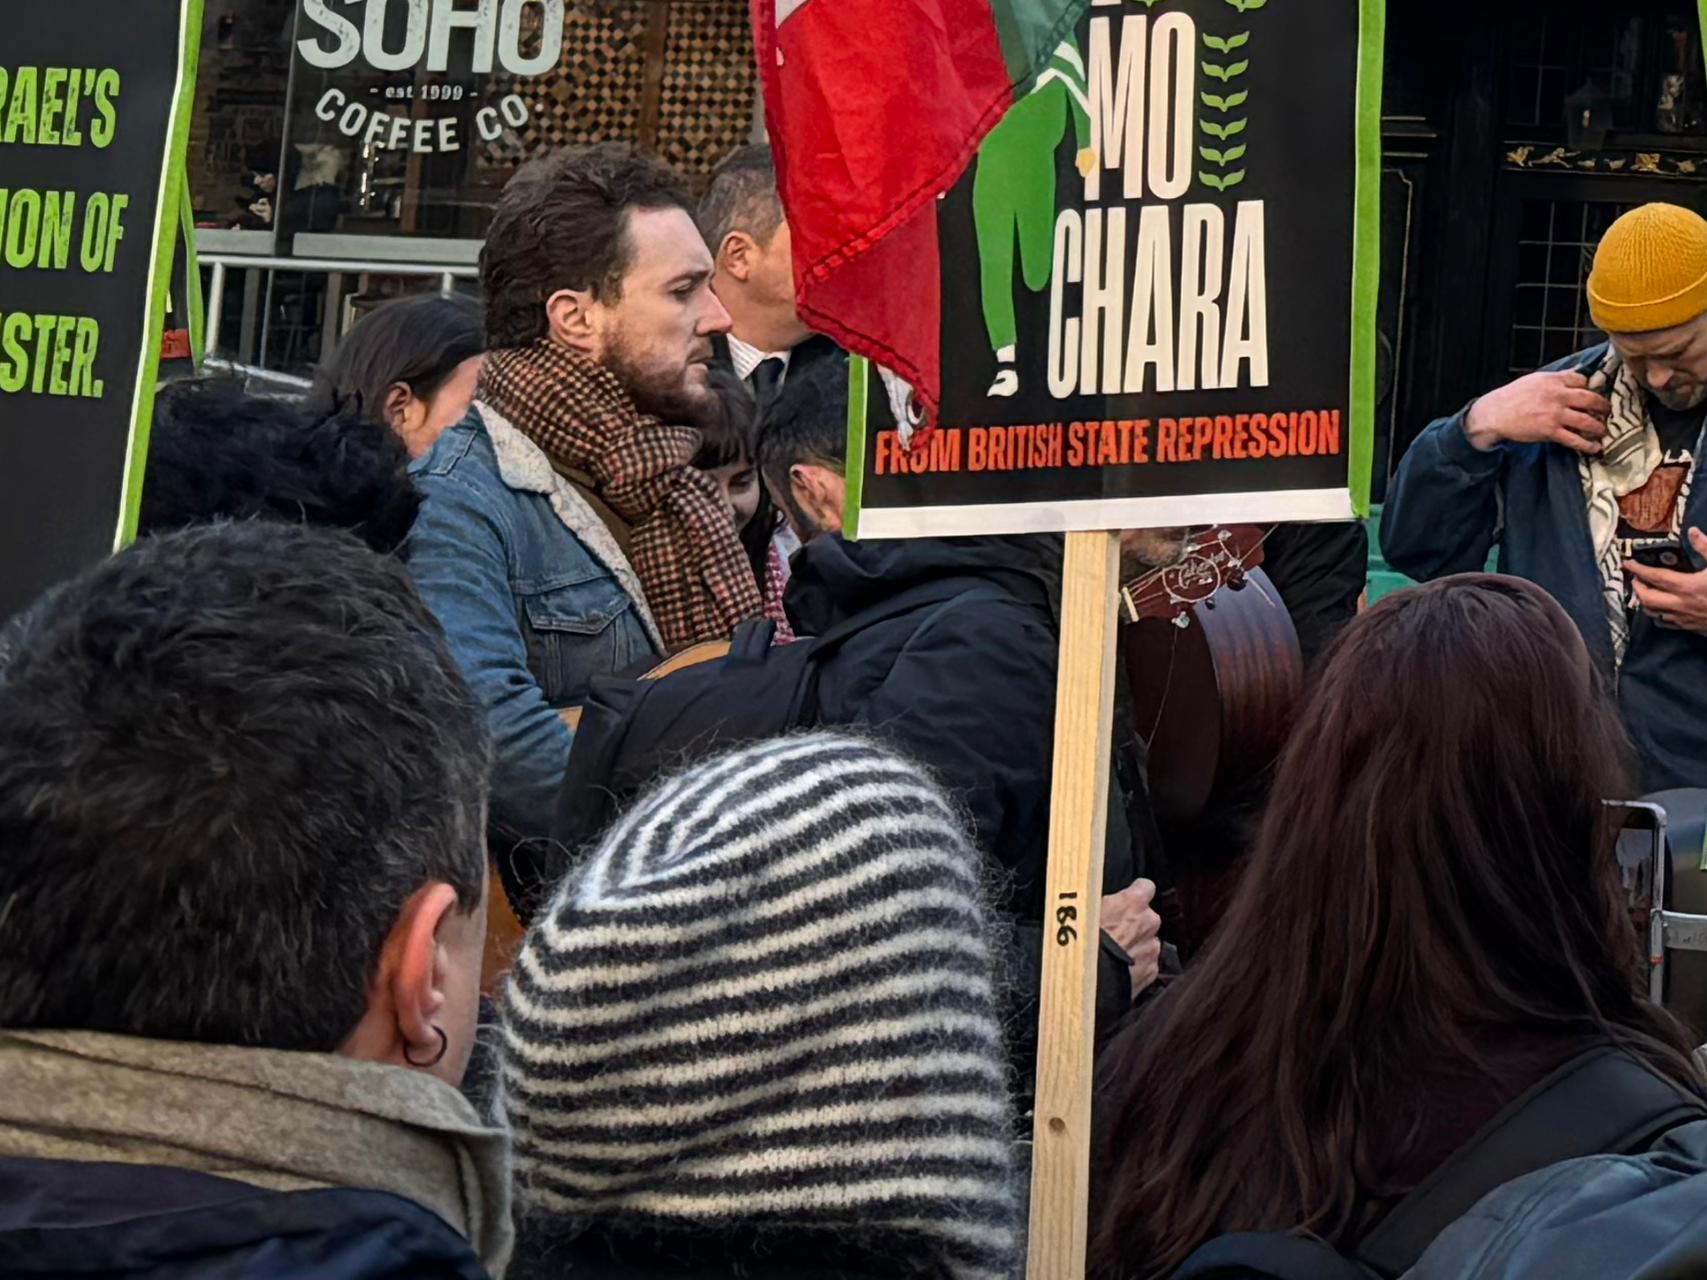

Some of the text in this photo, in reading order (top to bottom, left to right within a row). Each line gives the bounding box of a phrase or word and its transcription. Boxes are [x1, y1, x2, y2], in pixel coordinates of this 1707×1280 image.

[315, 88, 460, 153] COFFEE
[1084, 10, 1197, 202] MO
[80, 192, 128, 272] OF
[1047, 199, 1269, 399] CHARA
[967, 422, 1063, 472] BRITISH
[1066, 418, 1151, 466] STATE
[1156, 409, 1341, 463] REPRESSION
